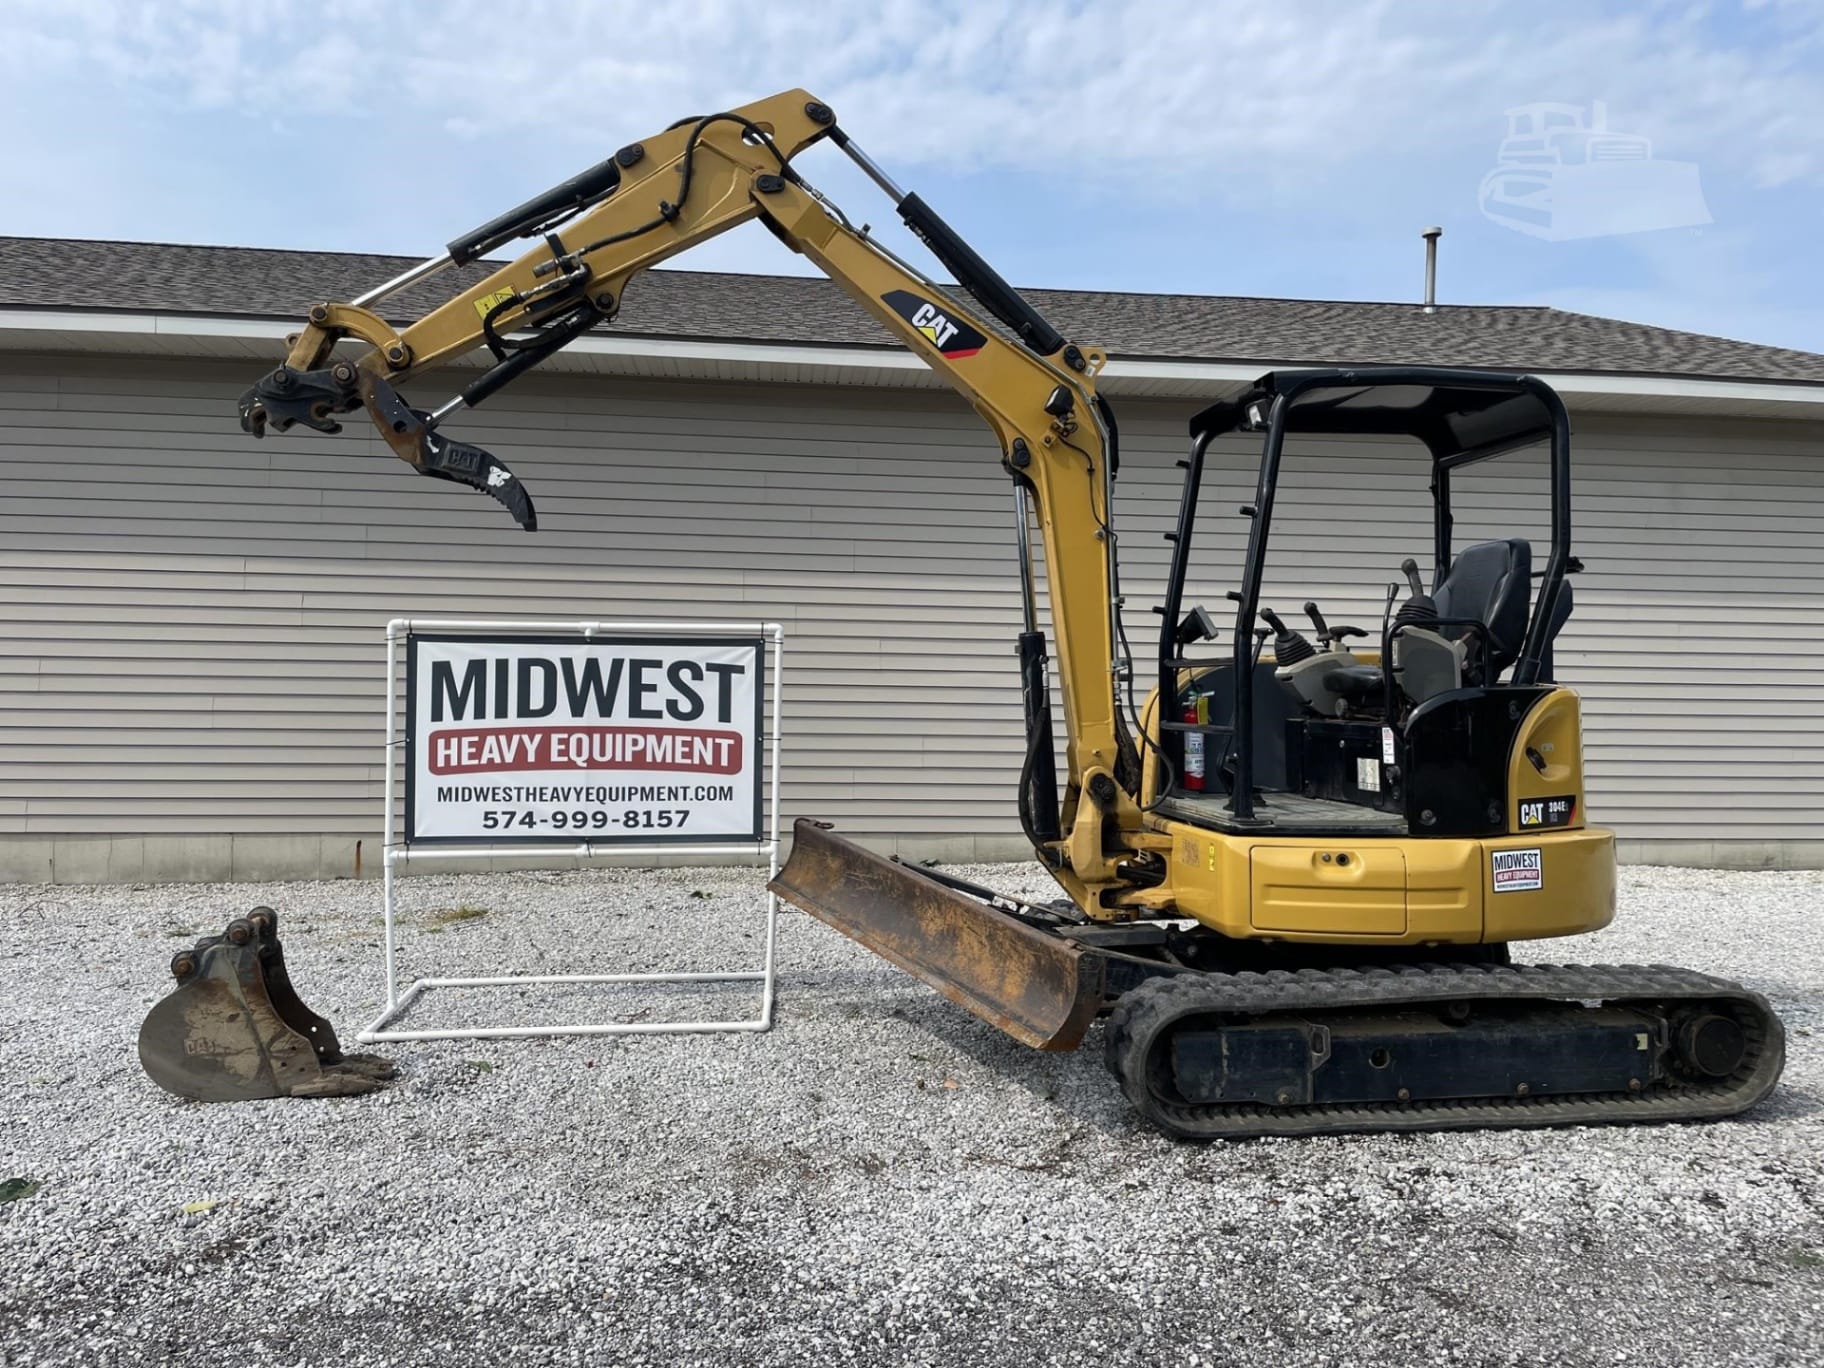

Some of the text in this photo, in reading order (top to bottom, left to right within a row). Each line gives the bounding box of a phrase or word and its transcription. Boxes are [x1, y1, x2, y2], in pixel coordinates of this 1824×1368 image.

[912, 303, 959, 348] CAT
[430, 656, 745, 723] MIDWEST
[436, 732, 735, 768] HEAVY EQUIPMENT
[437, 785, 734, 804] MIDWESTHEAVYEQUIPMENT.COM
[482, 809, 690, 829] 574-999-8157
[1521, 803, 1543, 825] CAT
[1494, 853, 1539, 871] MIDWEST
